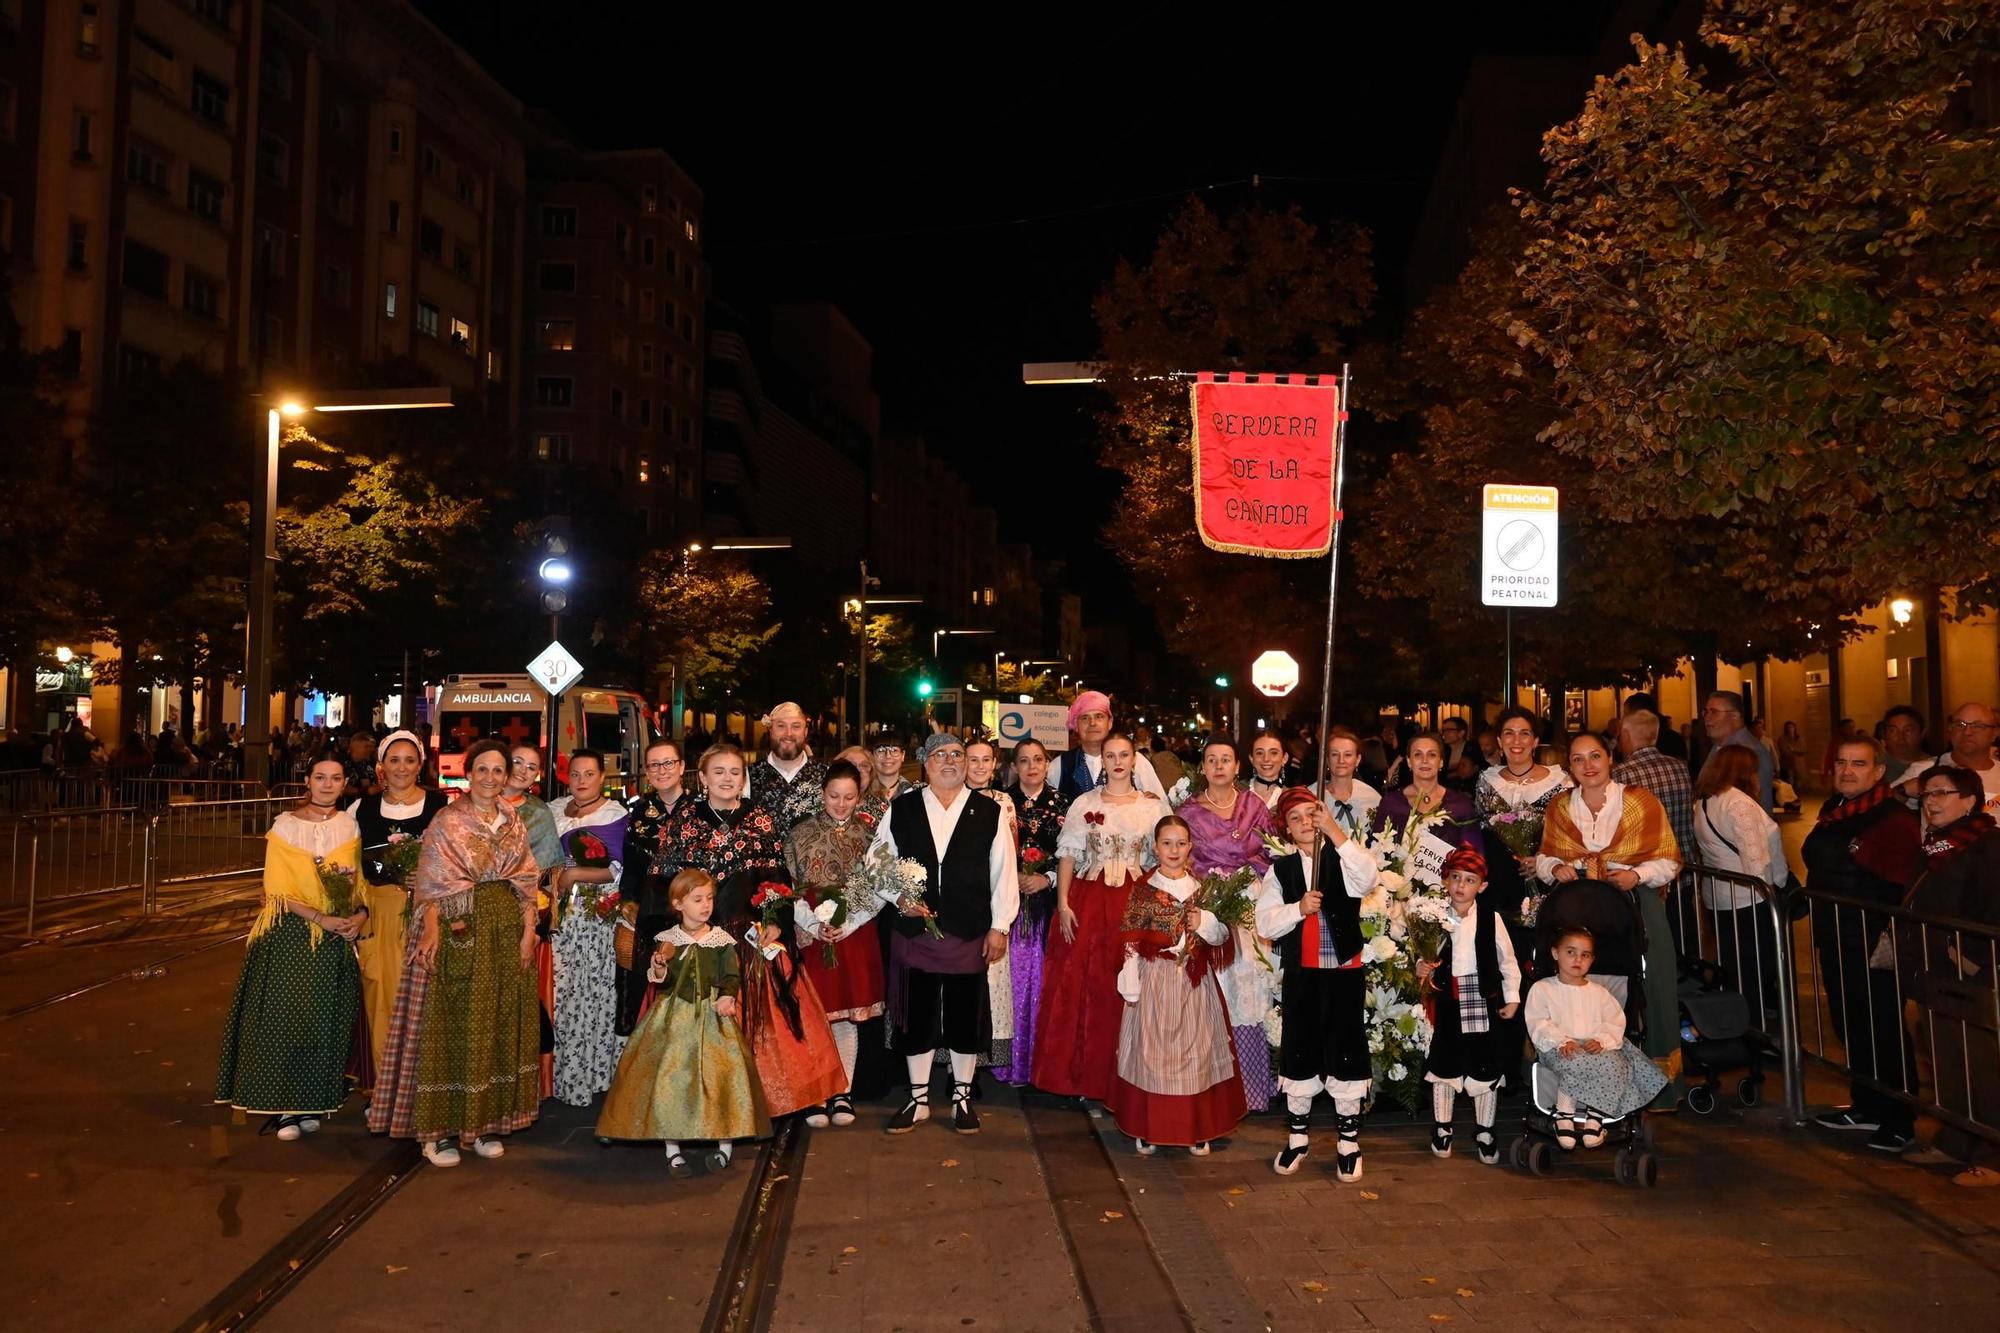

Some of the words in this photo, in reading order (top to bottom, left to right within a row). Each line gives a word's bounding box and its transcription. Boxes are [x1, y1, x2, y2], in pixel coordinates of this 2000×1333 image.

[1212, 412, 1317, 437] CERVERA
[1233, 458, 1259, 480] DE
[1270, 458, 1299, 480] LA
[1493, 493, 1550, 505] ATENCIÓN
[1226, 498, 1309, 526] CAÑADA
[1491, 575, 1550, 585] PRIORIDAD
[1492, 589, 1549, 600] PEATONAL
[543, 659, 567, 677] 30
[453, 693, 532, 703] AMBULANCIA
[1034, 710, 1059, 718] colegio
